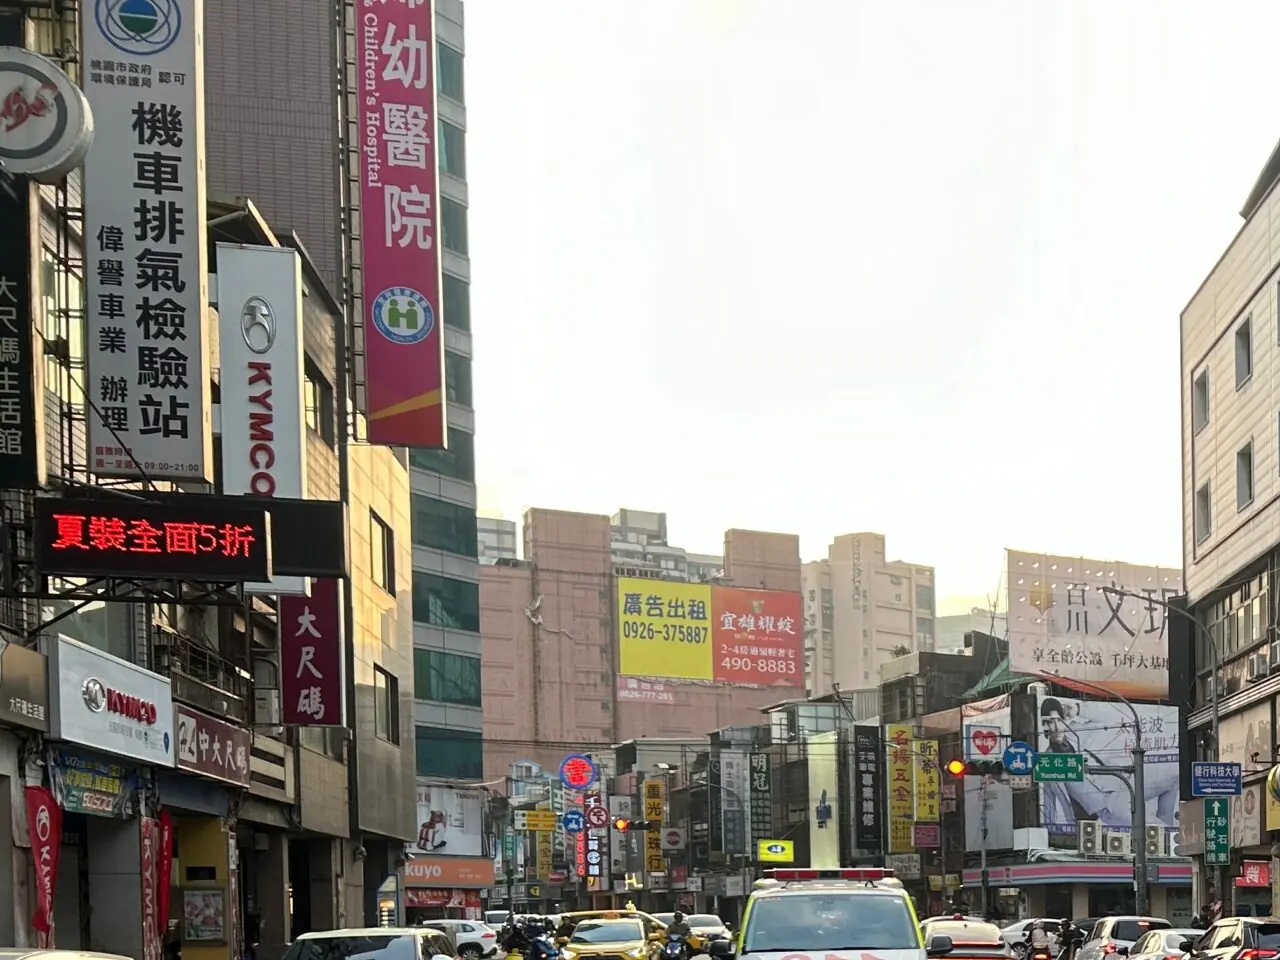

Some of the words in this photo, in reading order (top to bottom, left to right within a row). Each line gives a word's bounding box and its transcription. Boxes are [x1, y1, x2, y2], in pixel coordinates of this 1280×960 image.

[364, 13, 379, 105] Children's
[365, 111, 382, 187] Hospital
[381, 0, 433, 250] 幼醫院
[131, 101, 190, 439] 機車排氣檢驗站
[100, 376, 129, 432] 辦理
[247, 361, 276, 497] KYMCO
[51, 513, 256, 558] 夏裝全面5折
[623, 593, 708, 620] 廣告出租
[623, 621, 708, 643] 0926-375887
[295, 577, 326, 720] 大尺碼
[721, 657, 796, 674] 490-8883
[107, 687, 157, 725] KYMCO
[1040, 758, 1077, 767] 元化路
[1194, 766, 1241, 777] 健行科技大學
[647, 784, 662, 870] 重光珠行
